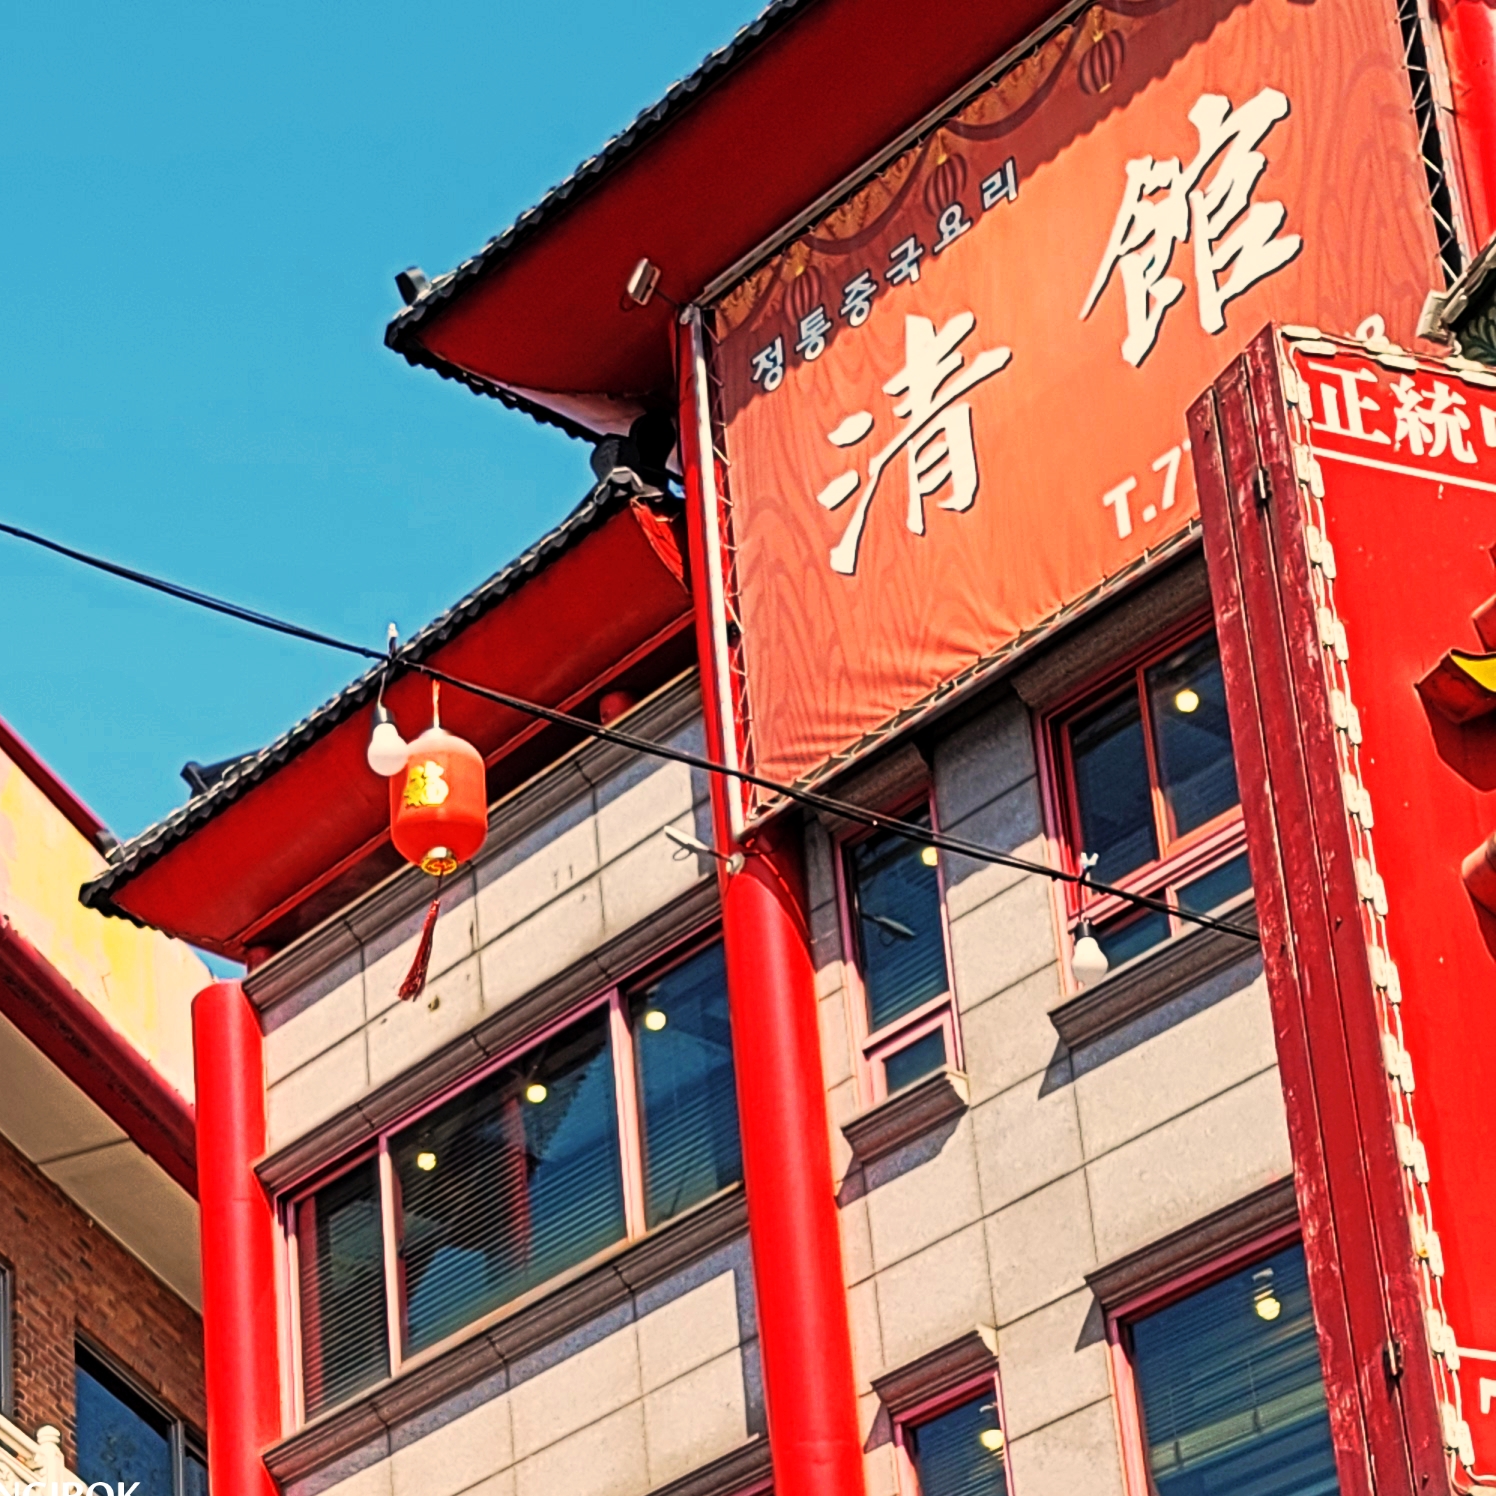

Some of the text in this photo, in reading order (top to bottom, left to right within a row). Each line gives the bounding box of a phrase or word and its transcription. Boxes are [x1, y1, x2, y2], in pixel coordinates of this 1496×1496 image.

[751, 158, 1018, 392] 정통중국요리
[1308, 360, 1496, 464] 正統
[1102, 438, 1192, 540] T.7
